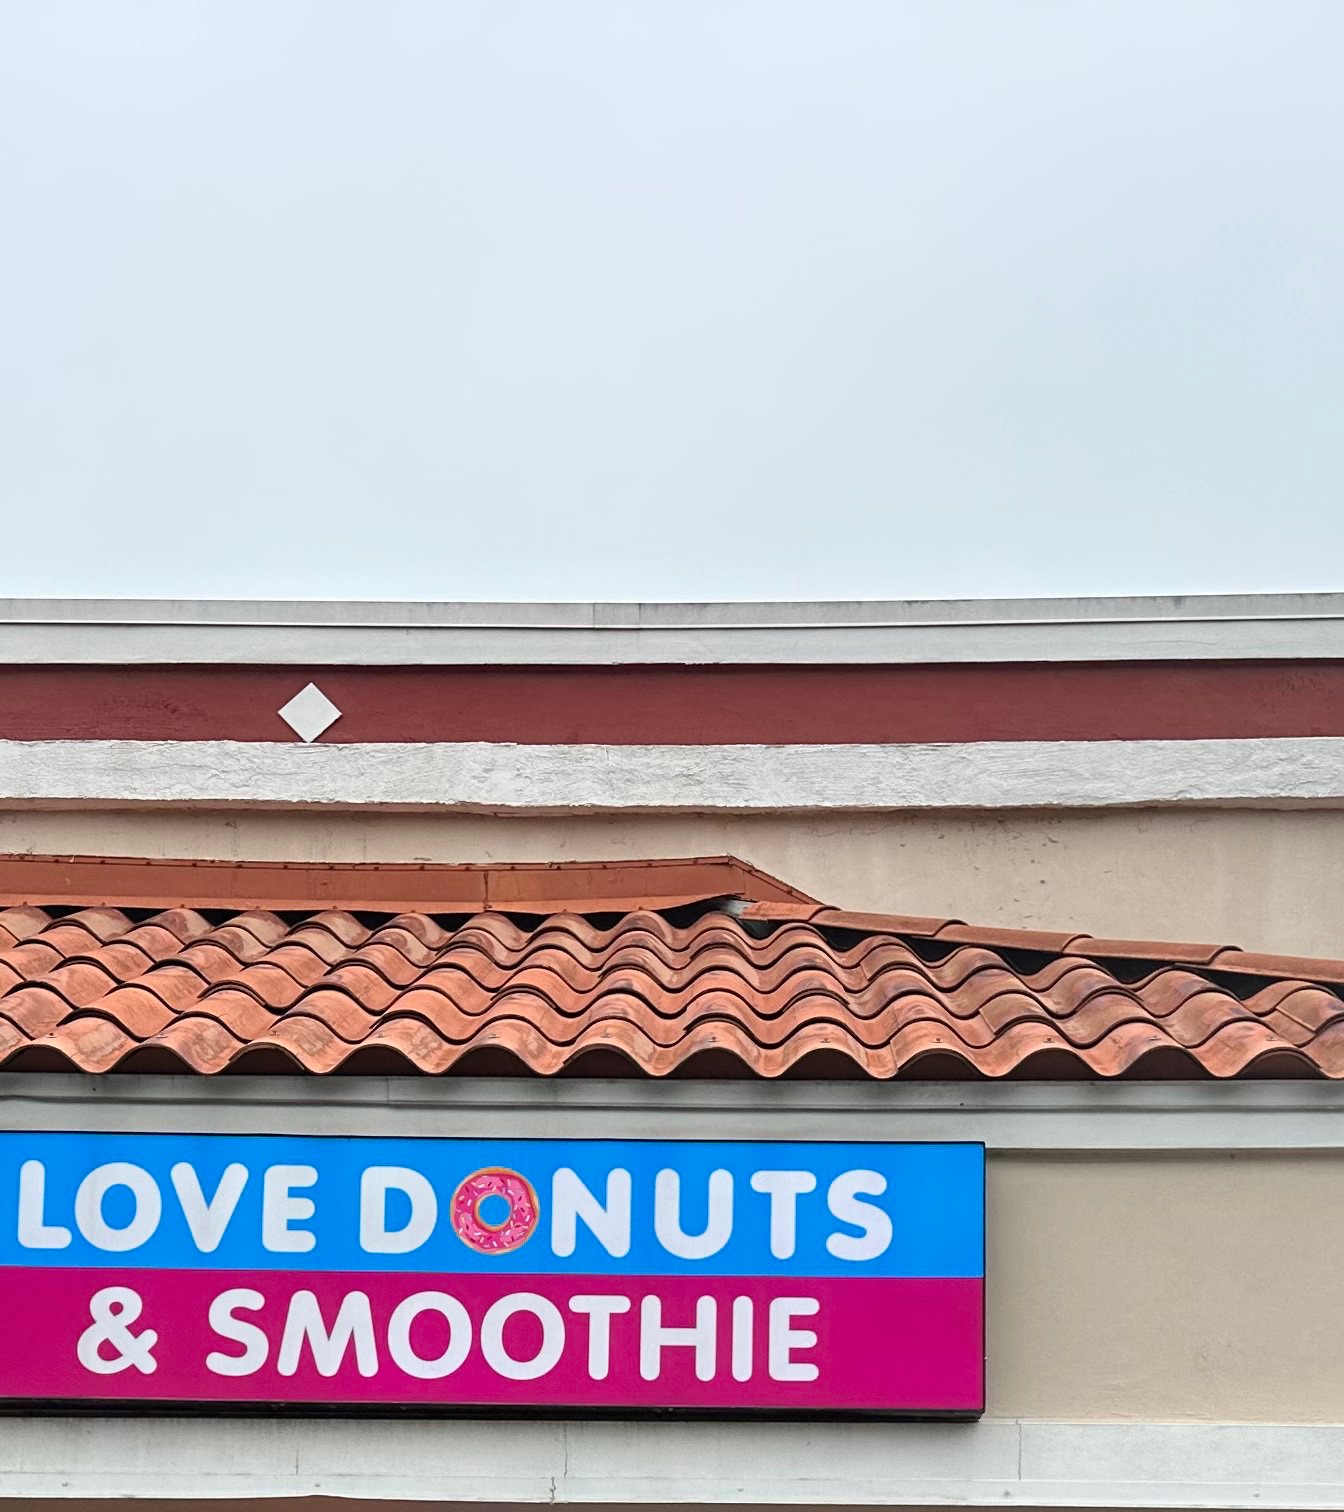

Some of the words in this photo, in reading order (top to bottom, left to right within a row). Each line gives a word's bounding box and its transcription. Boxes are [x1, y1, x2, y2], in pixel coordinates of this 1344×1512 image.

[17, 1160, 318, 1254] LOVE
[359, 1167, 894, 1262] DONUTS
[76, 1286, 158, 1376] &
[205, 1289, 820, 1383] SMOOTHIE
